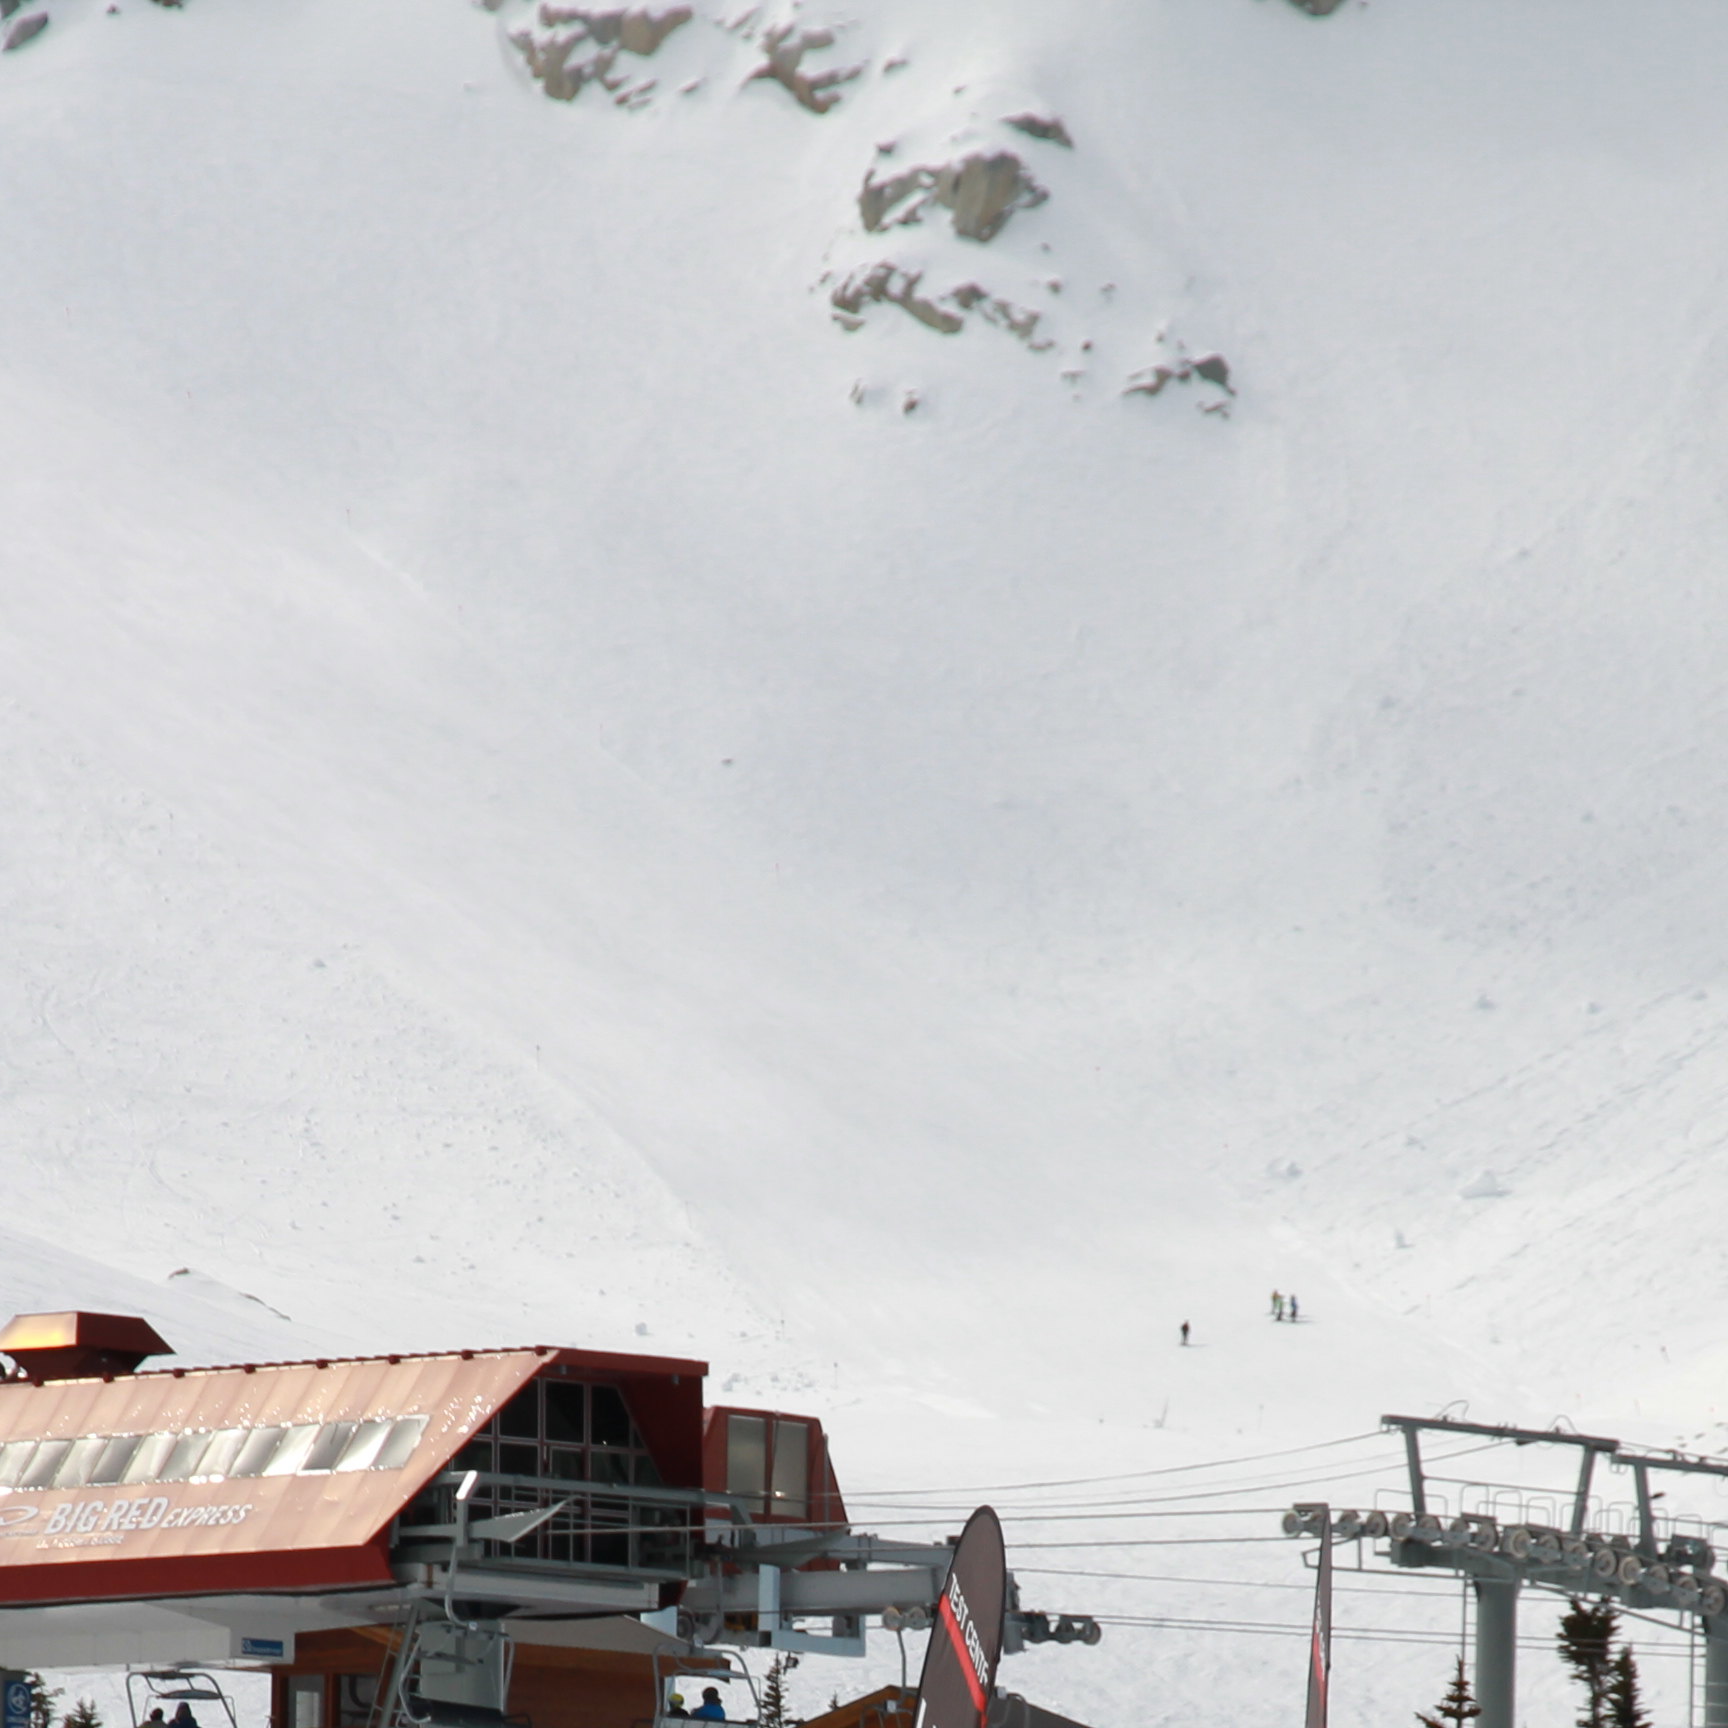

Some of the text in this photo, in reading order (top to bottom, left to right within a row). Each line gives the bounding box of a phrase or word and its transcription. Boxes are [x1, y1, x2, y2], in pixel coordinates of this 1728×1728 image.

[44, 1497, 253, 1535] BIG RED EXPRESS
[949, 1572, 970, 1630] TEST
